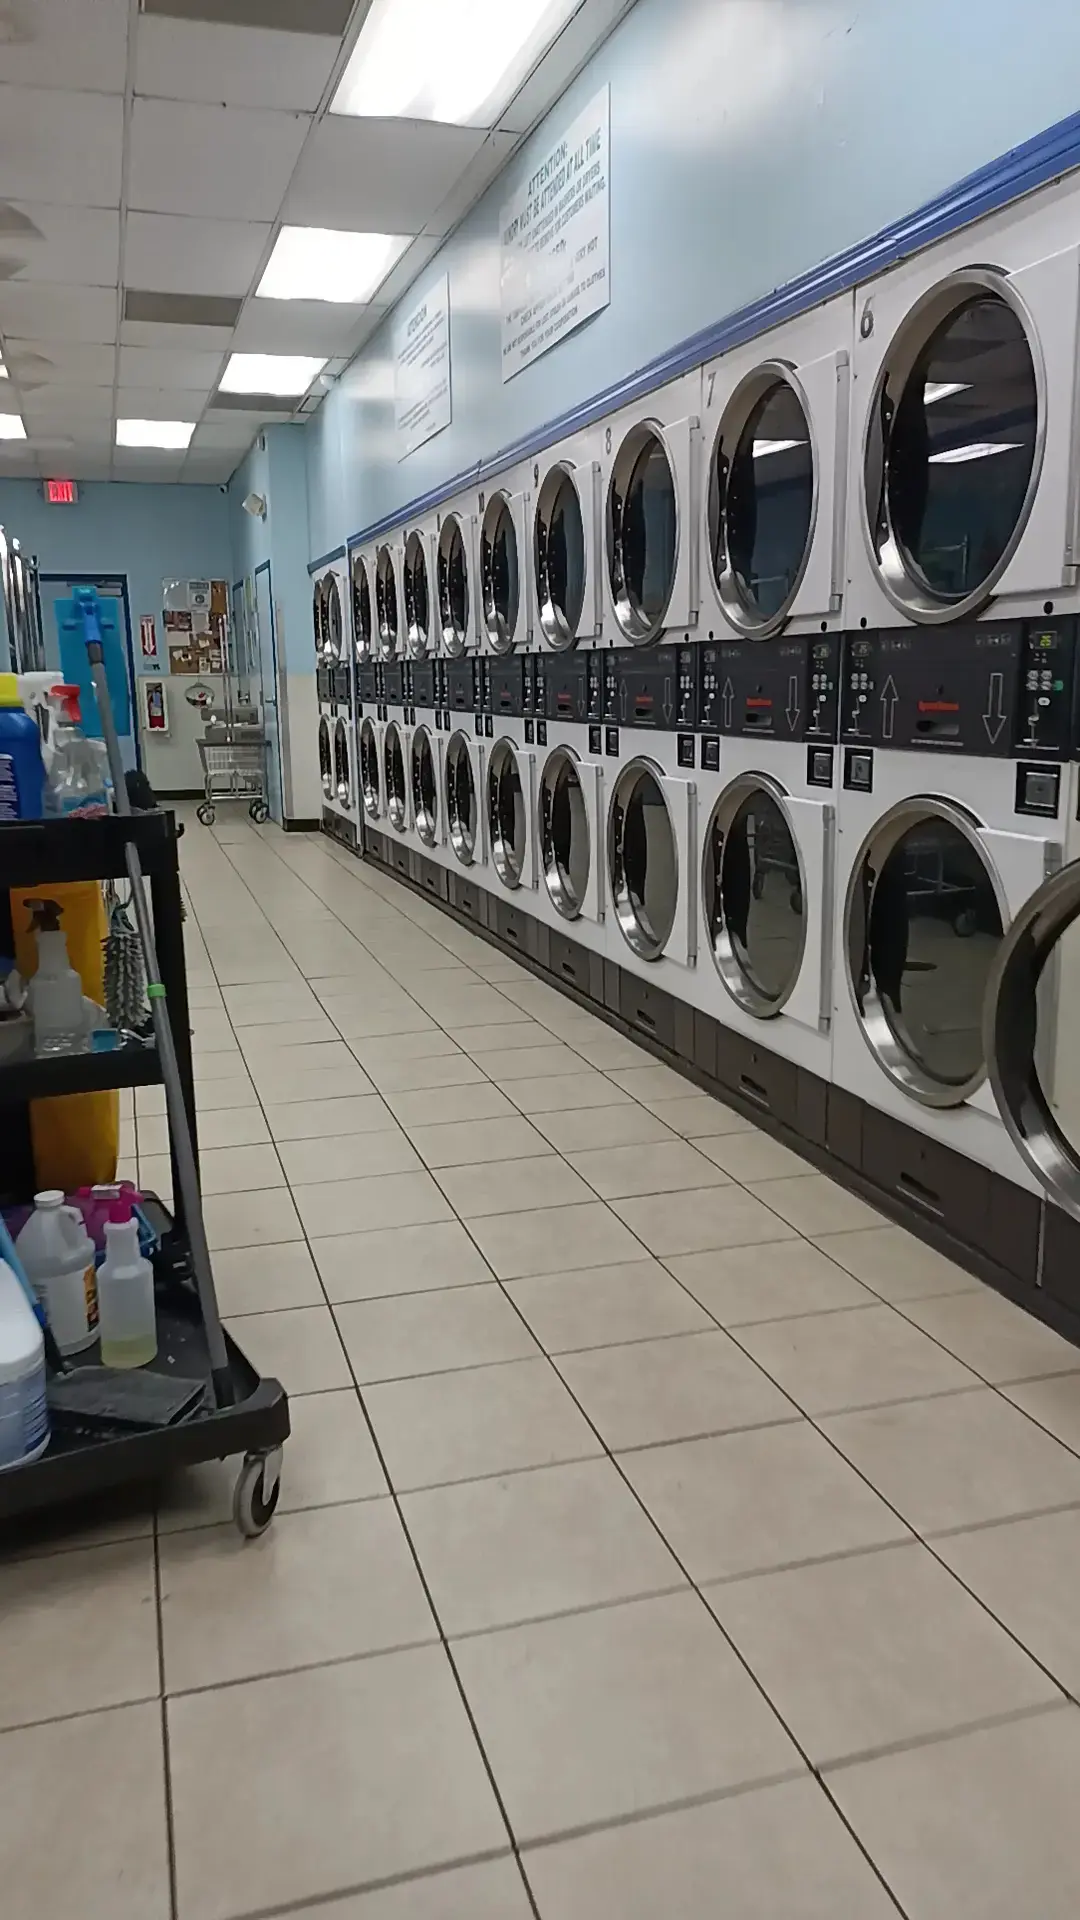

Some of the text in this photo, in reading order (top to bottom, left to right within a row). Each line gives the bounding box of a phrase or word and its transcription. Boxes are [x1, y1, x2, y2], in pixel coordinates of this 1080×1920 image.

[527, 140, 568, 197] ATTENTION:
[533, 194, 539, 216] BE
[540, 168, 564, 208] ATTENDED
[566, 158, 572, 181] AT
[574, 145, 583, 173] ALL
[587, 236, 598, 254] HOT
[861, 294, 875, 339] 6
[706, 372, 716, 408] 7
[605, 427, 612, 455] 8
[48, 481, 73, 502] EXIT
[533, 463, 539, 488] 9
